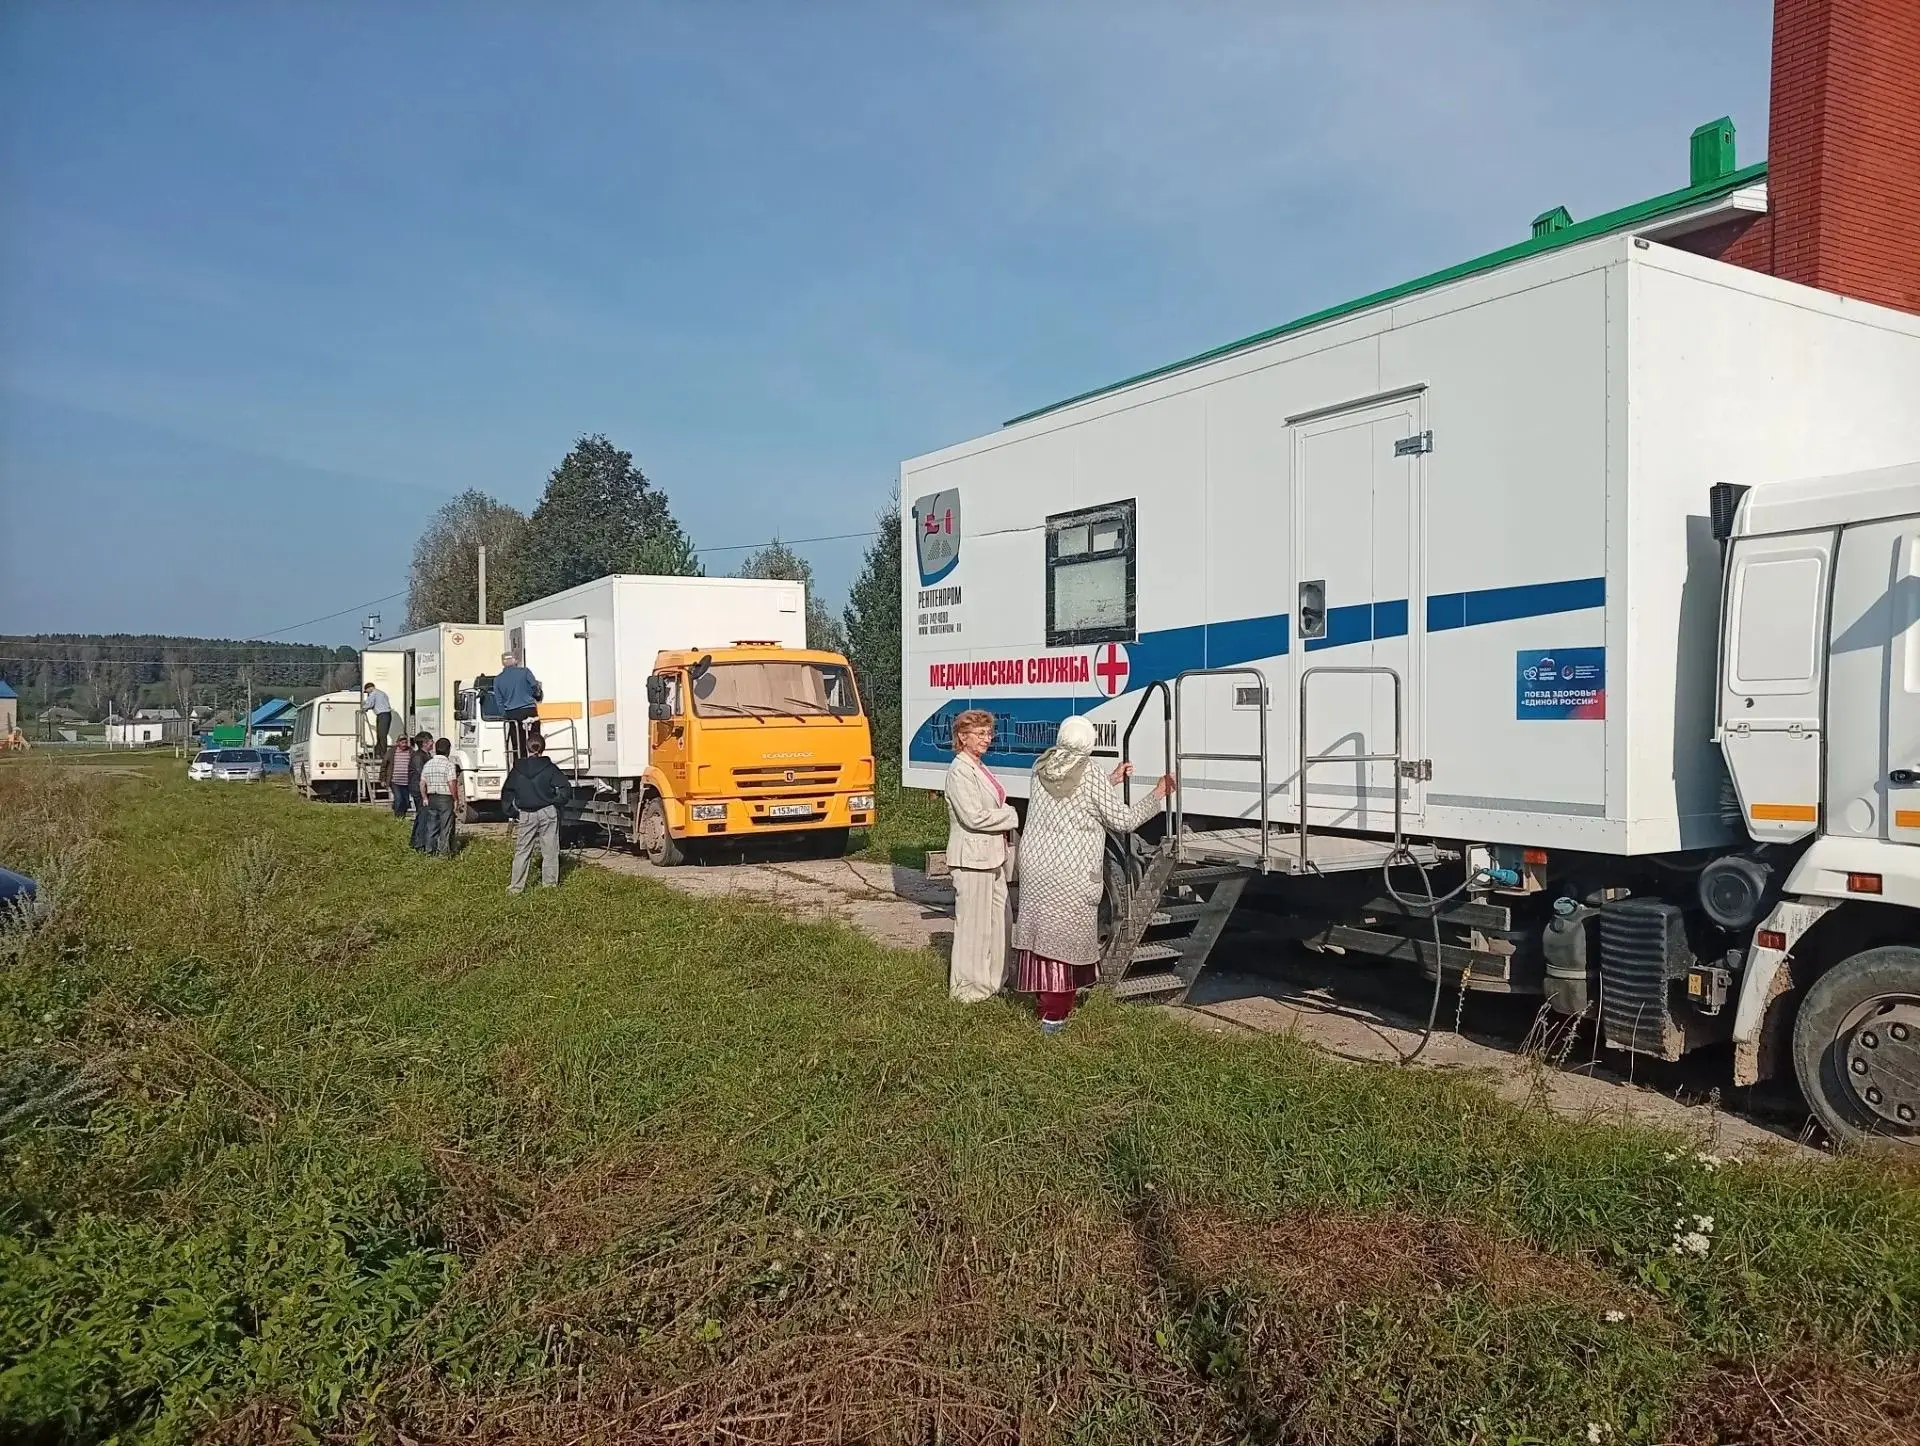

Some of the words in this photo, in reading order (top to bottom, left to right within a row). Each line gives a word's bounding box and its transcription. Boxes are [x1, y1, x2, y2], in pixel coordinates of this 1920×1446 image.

[929, 659, 1024, 690] МЕДИЦИНСКАЯ
[1027, 655, 1090, 684] СЛУЖБА
[1552, 690, 1597, 698] ЗДОРОВЬЯ
[1521, 698, 1558, 706] «ЕДИНОЙ
